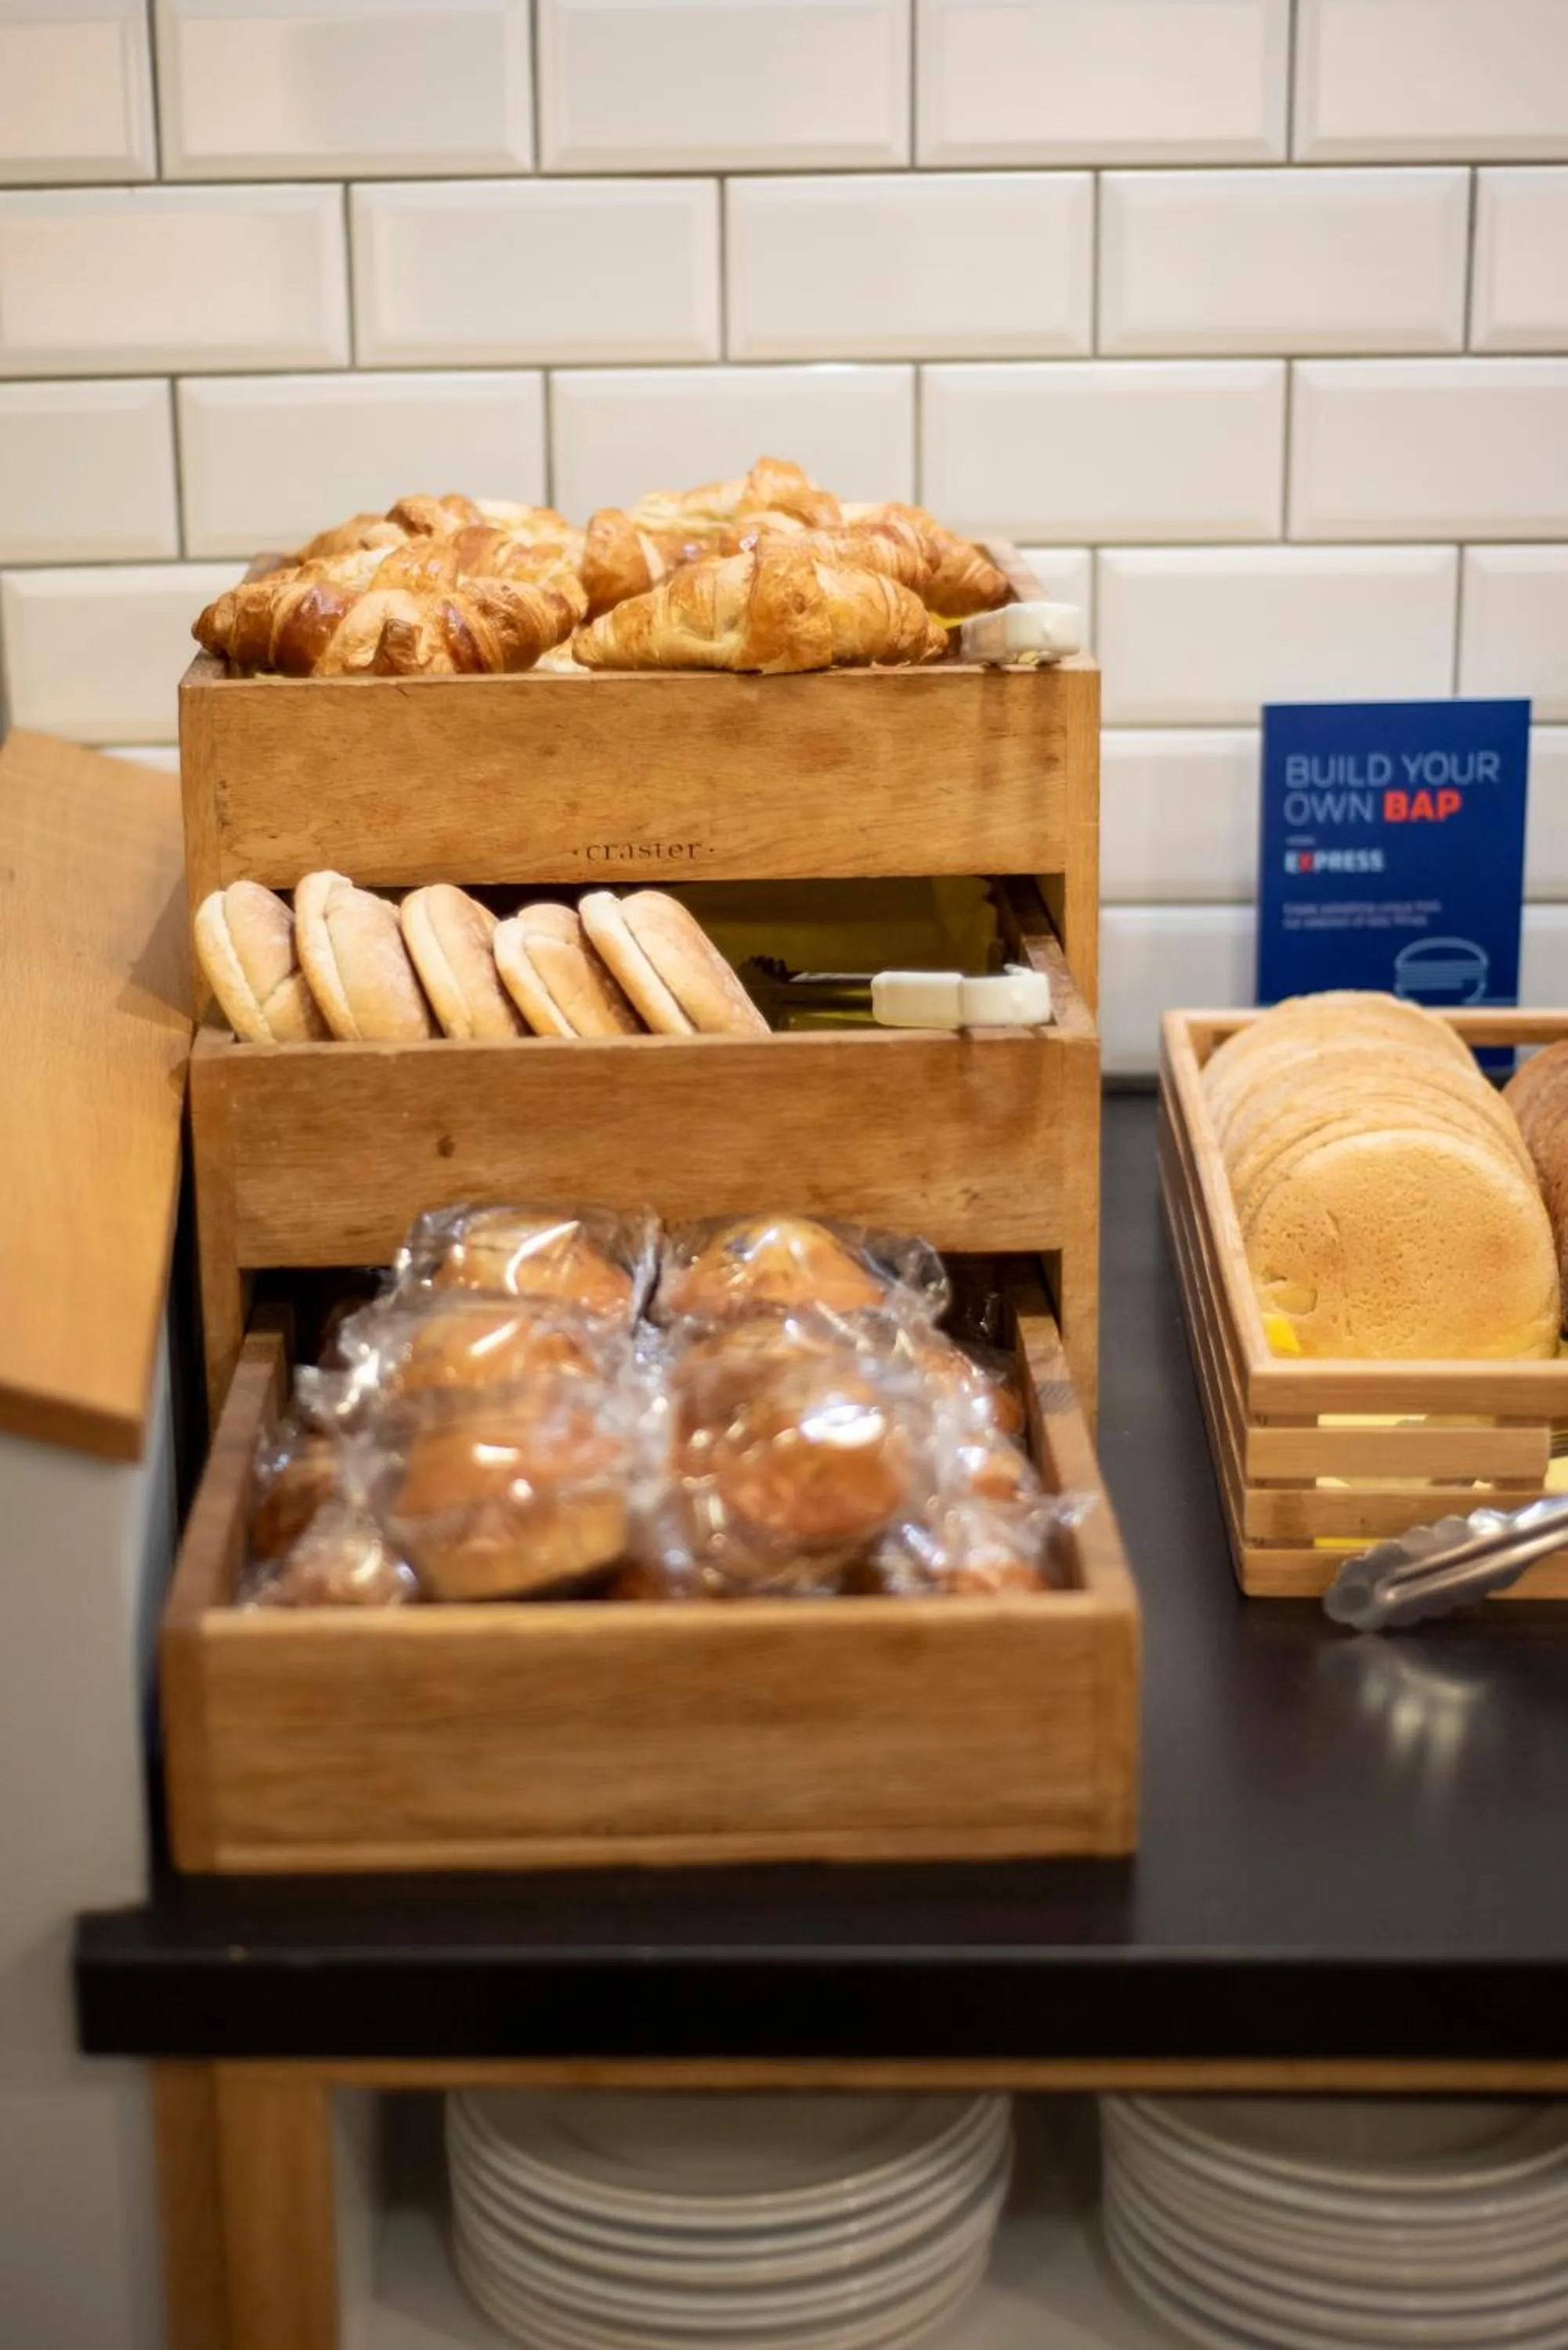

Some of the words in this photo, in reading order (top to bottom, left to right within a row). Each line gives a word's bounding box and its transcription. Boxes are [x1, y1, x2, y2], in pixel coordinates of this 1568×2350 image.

[1285, 753, 1392, 789] BUILD
[1400, 750, 1501, 786] YOUR
[1283, 790, 1374, 826] OWN
[1382, 788, 1462, 822] BAP
[1284, 848, 1384, 874] EXPRESS
